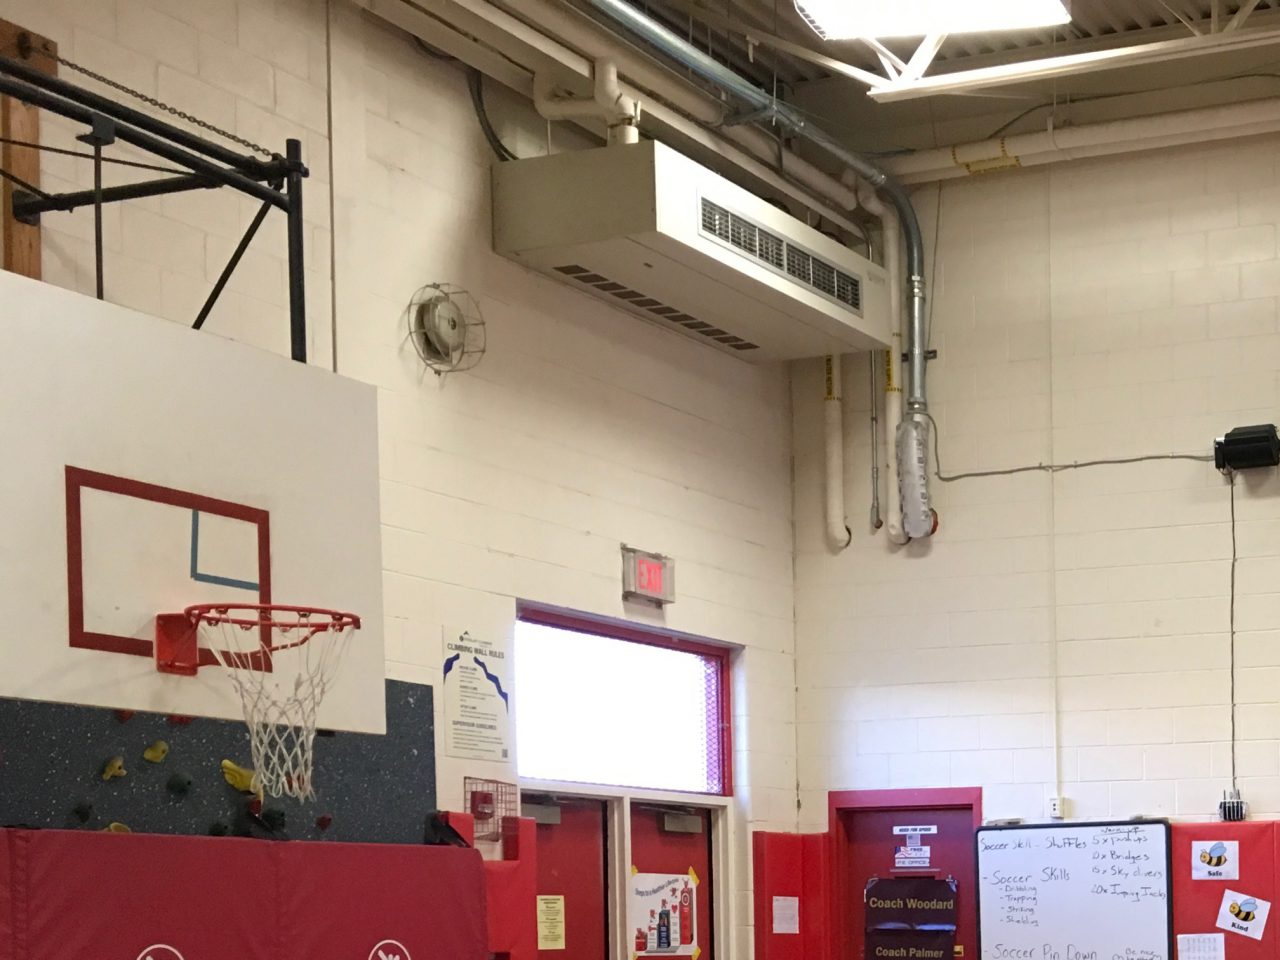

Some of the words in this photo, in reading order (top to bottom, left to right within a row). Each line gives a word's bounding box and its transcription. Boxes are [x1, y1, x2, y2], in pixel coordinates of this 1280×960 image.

[637, 559, 663, 593] EXIT
[991, 870, 1033, 886] Soccer
[870, 896, 904, 909] Coach
[906, 899, 954, 910] Woodard
[1231, 921, 1249, 932] Kind
[876, 946, 906, 957] Coach
[909, 948, 944, 959] Palmer
[992, 944, 1036, 960] Soccer
[1043, 944, 1060, 960] Pin
[1066, 944, 1098, 960] Down
